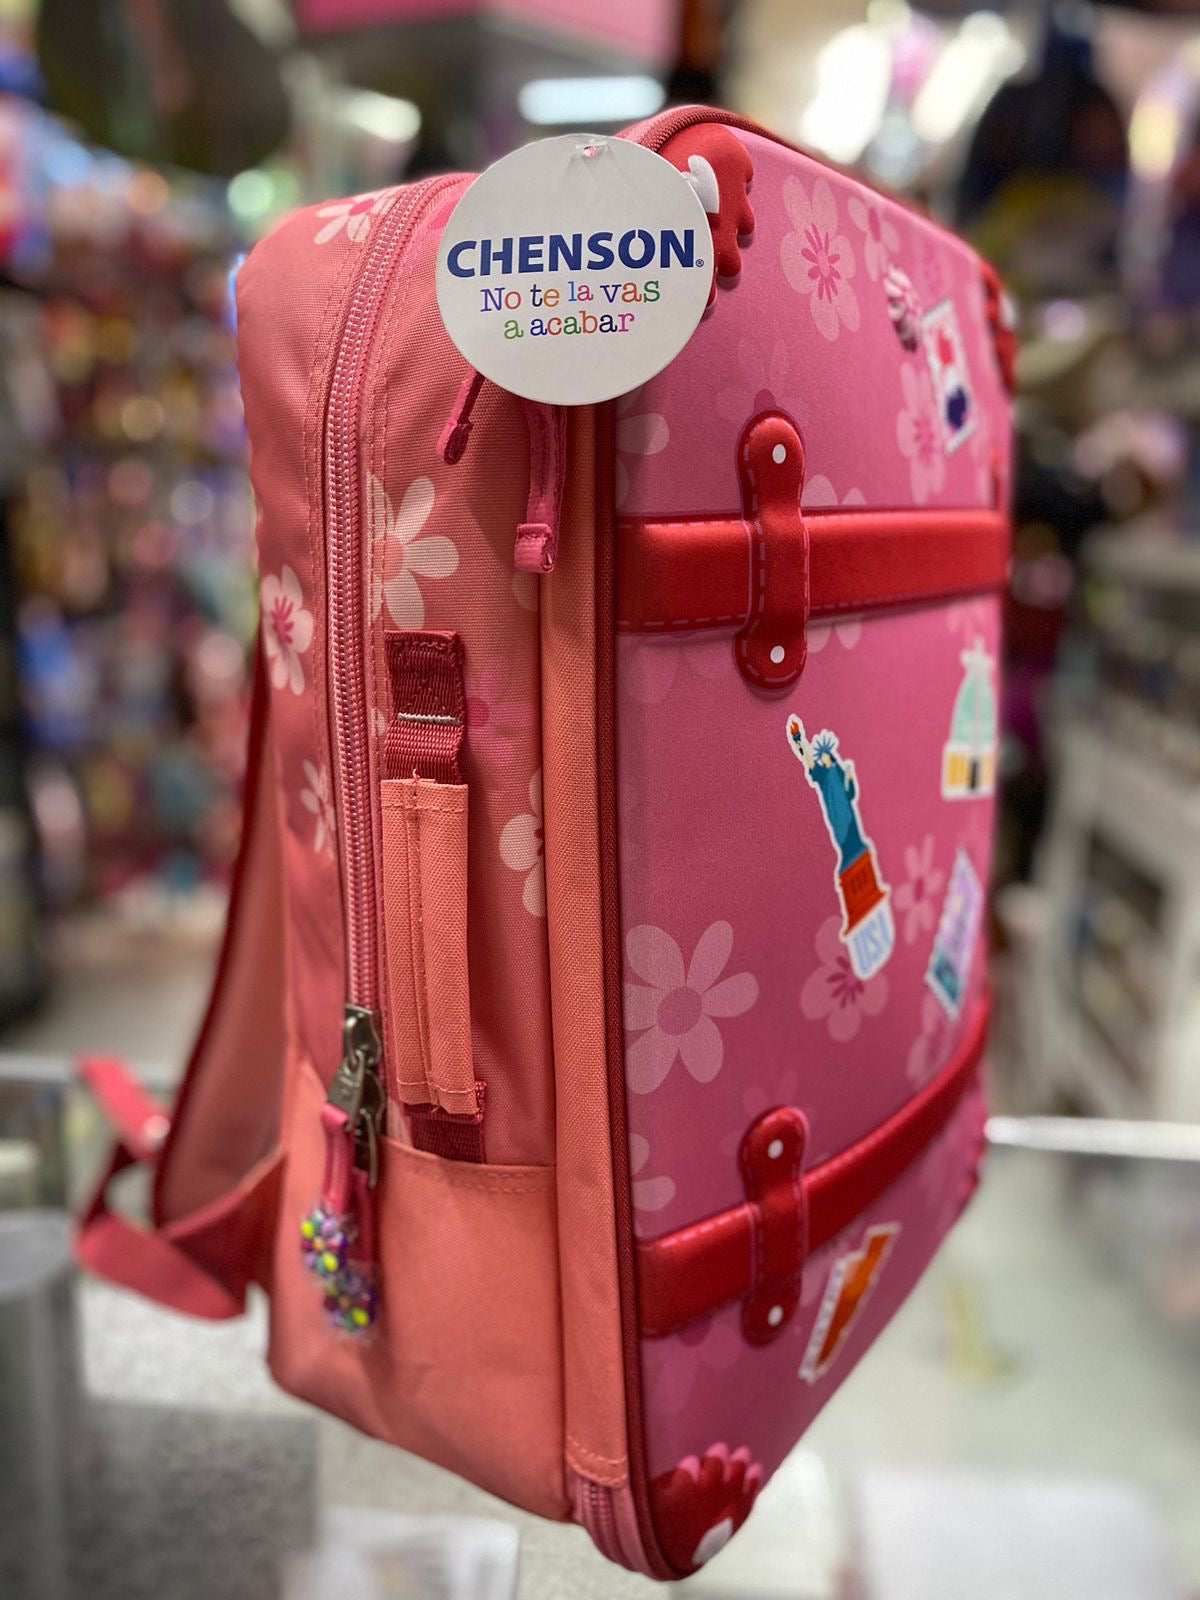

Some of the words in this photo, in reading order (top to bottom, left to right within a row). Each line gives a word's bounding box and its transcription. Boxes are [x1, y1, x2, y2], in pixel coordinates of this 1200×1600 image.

[480, 287, 522, 312] No
[530, 284, 561, 308] te
[567, 280, 594, 303] la
[600, 280, 661, 304] vas
[504, 319, 524, 339] a
[530, 310, 635, 337] acabar
[852, 910, 892, 976] USA
